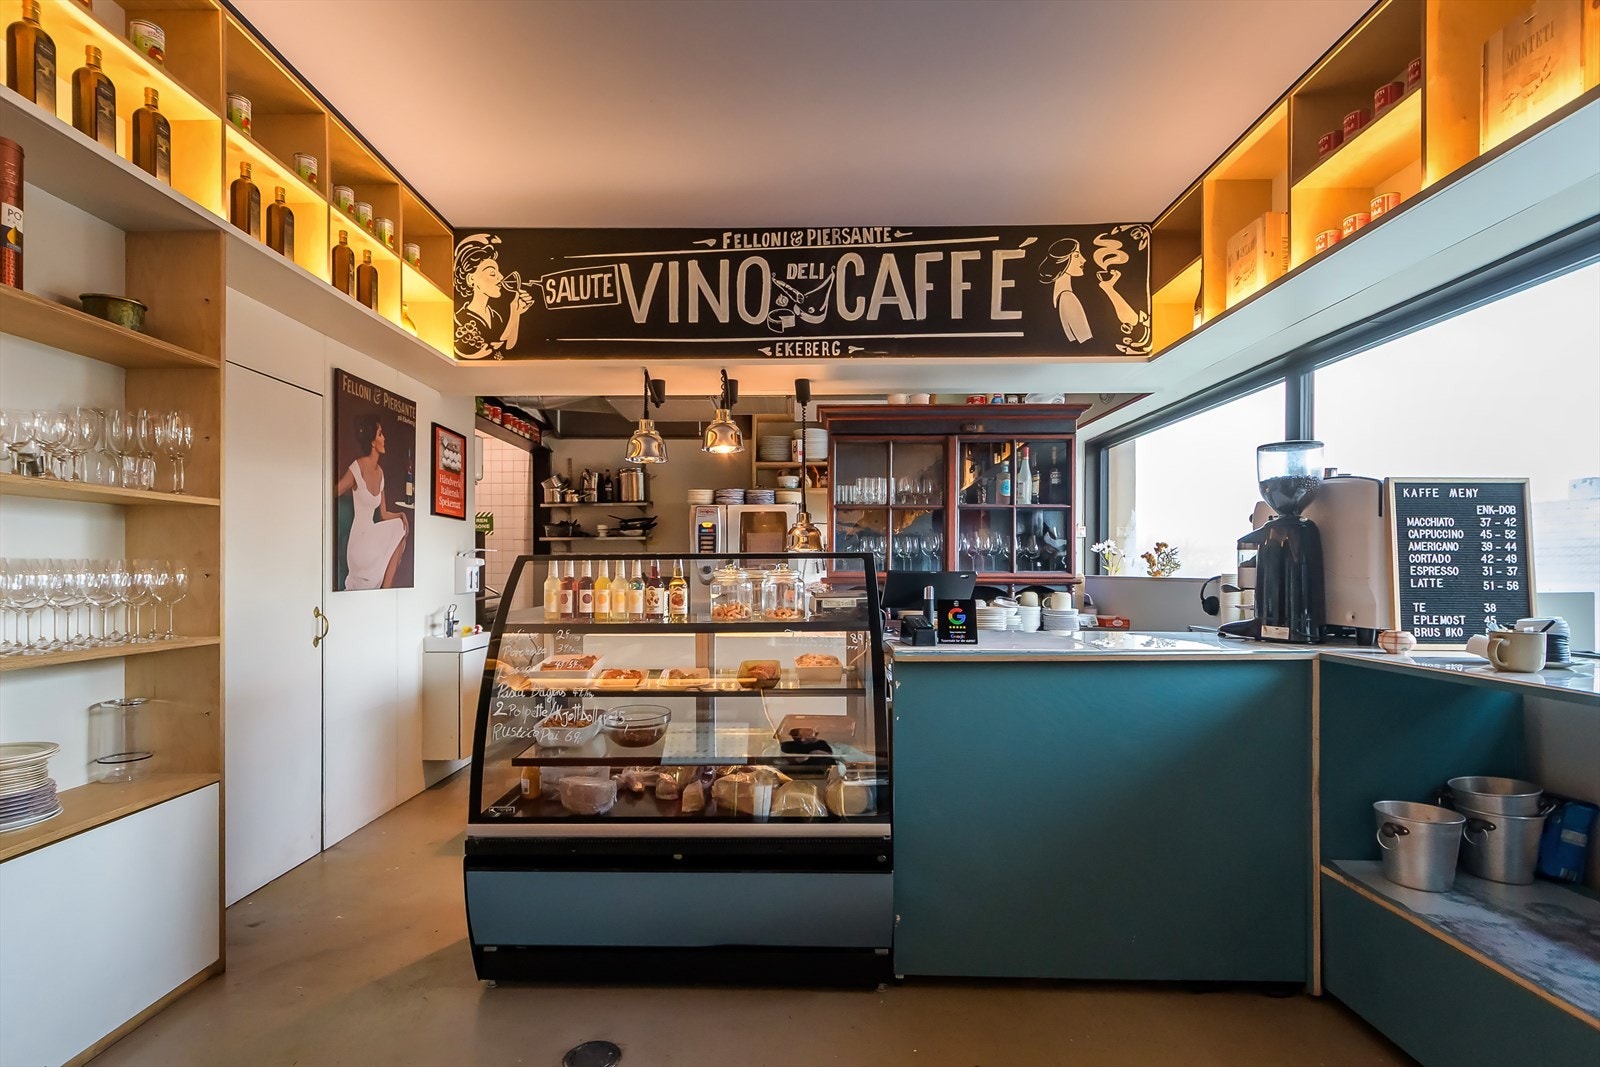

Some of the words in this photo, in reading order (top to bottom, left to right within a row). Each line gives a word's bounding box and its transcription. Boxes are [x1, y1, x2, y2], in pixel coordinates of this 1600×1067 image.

[722, 231, 788, 249] FELLONI
[790, 230, 804, 246] &
[806, 227, 892, 246] PIERSANTE
[618, 255, 772, 324] VINO
[786, 262, 825, 280] DELI
[836, 237, 1038, 321] CAFFÉ
[546, 272, 614, 304] SALUTE
[775, 341, 841, 357] EKEBERG
[342, 374, 372, 401] FELLONI
[383, 391, 416, 419] PIERSANTE
[1403, 488, 1439, 498] KAFFE
[1449, 488, 1479, 498] MENY
[1476, 505, 1517, 515] ENK-DOB
[1406, 517, 1455, 527] MACCHIATO
[1480, 517, 1491, 527] 37
[1504, 517, 1517, 527] 42
[1408, 529, 1464, 539] CAPPUCCINO
[1480, 529, 1493, 539] 45
[1504, 529, 1517, 539] 52
[1408, 541, 1460, 551] AMERICANO
[1481, 541, 1493, 551] 39
[1504, 541, 1517, 551] 44
[1408, 553, 1452, 563] CORTADO
[1480, 554, 1494, 563] 42
[1504, 554, 1517, 564] 49
[1410, 565, 1460, 576] ESPRESSO
[1482, 566, 1493, 576] 31
[1506, 566, 1518, 576] 37
[1410, 578, 1444, 588] LATTE
[1483, 580, 1495, 590] 51
[1412, 602, 1426, 612] TE
[1483, 602, 1497, 613] 38
[1413, 615, 1466, 625] EPLEMOST
[1414, 627, 1441, 637] BRUS
[493, 701, 508, 716] 2
